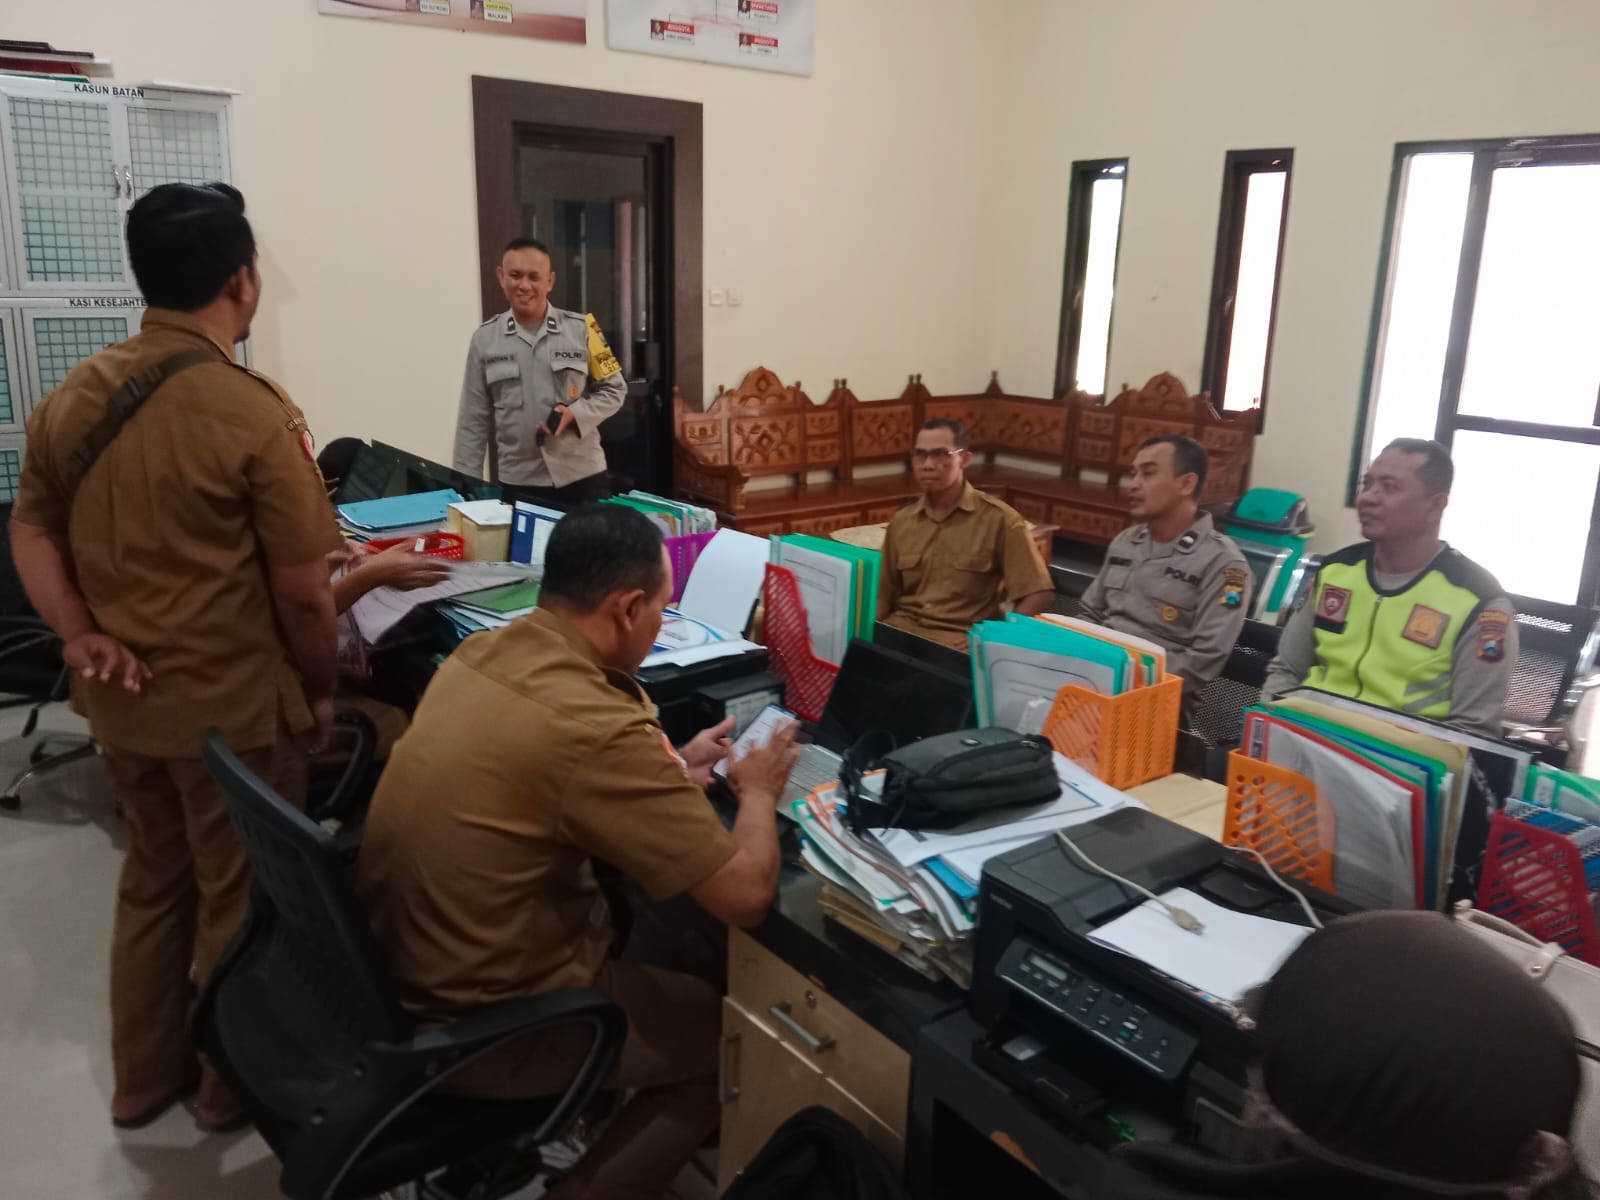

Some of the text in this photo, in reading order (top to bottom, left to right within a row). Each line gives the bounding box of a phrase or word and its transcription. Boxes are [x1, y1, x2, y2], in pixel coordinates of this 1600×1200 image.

[74, 83, 144, 98] KASUN BATAN
[69, 298, 147, 307] KASI KESEJAHTE
[554, 351, 583, 359] POLRI
[1164, 566, 1201, 587] POLRI
